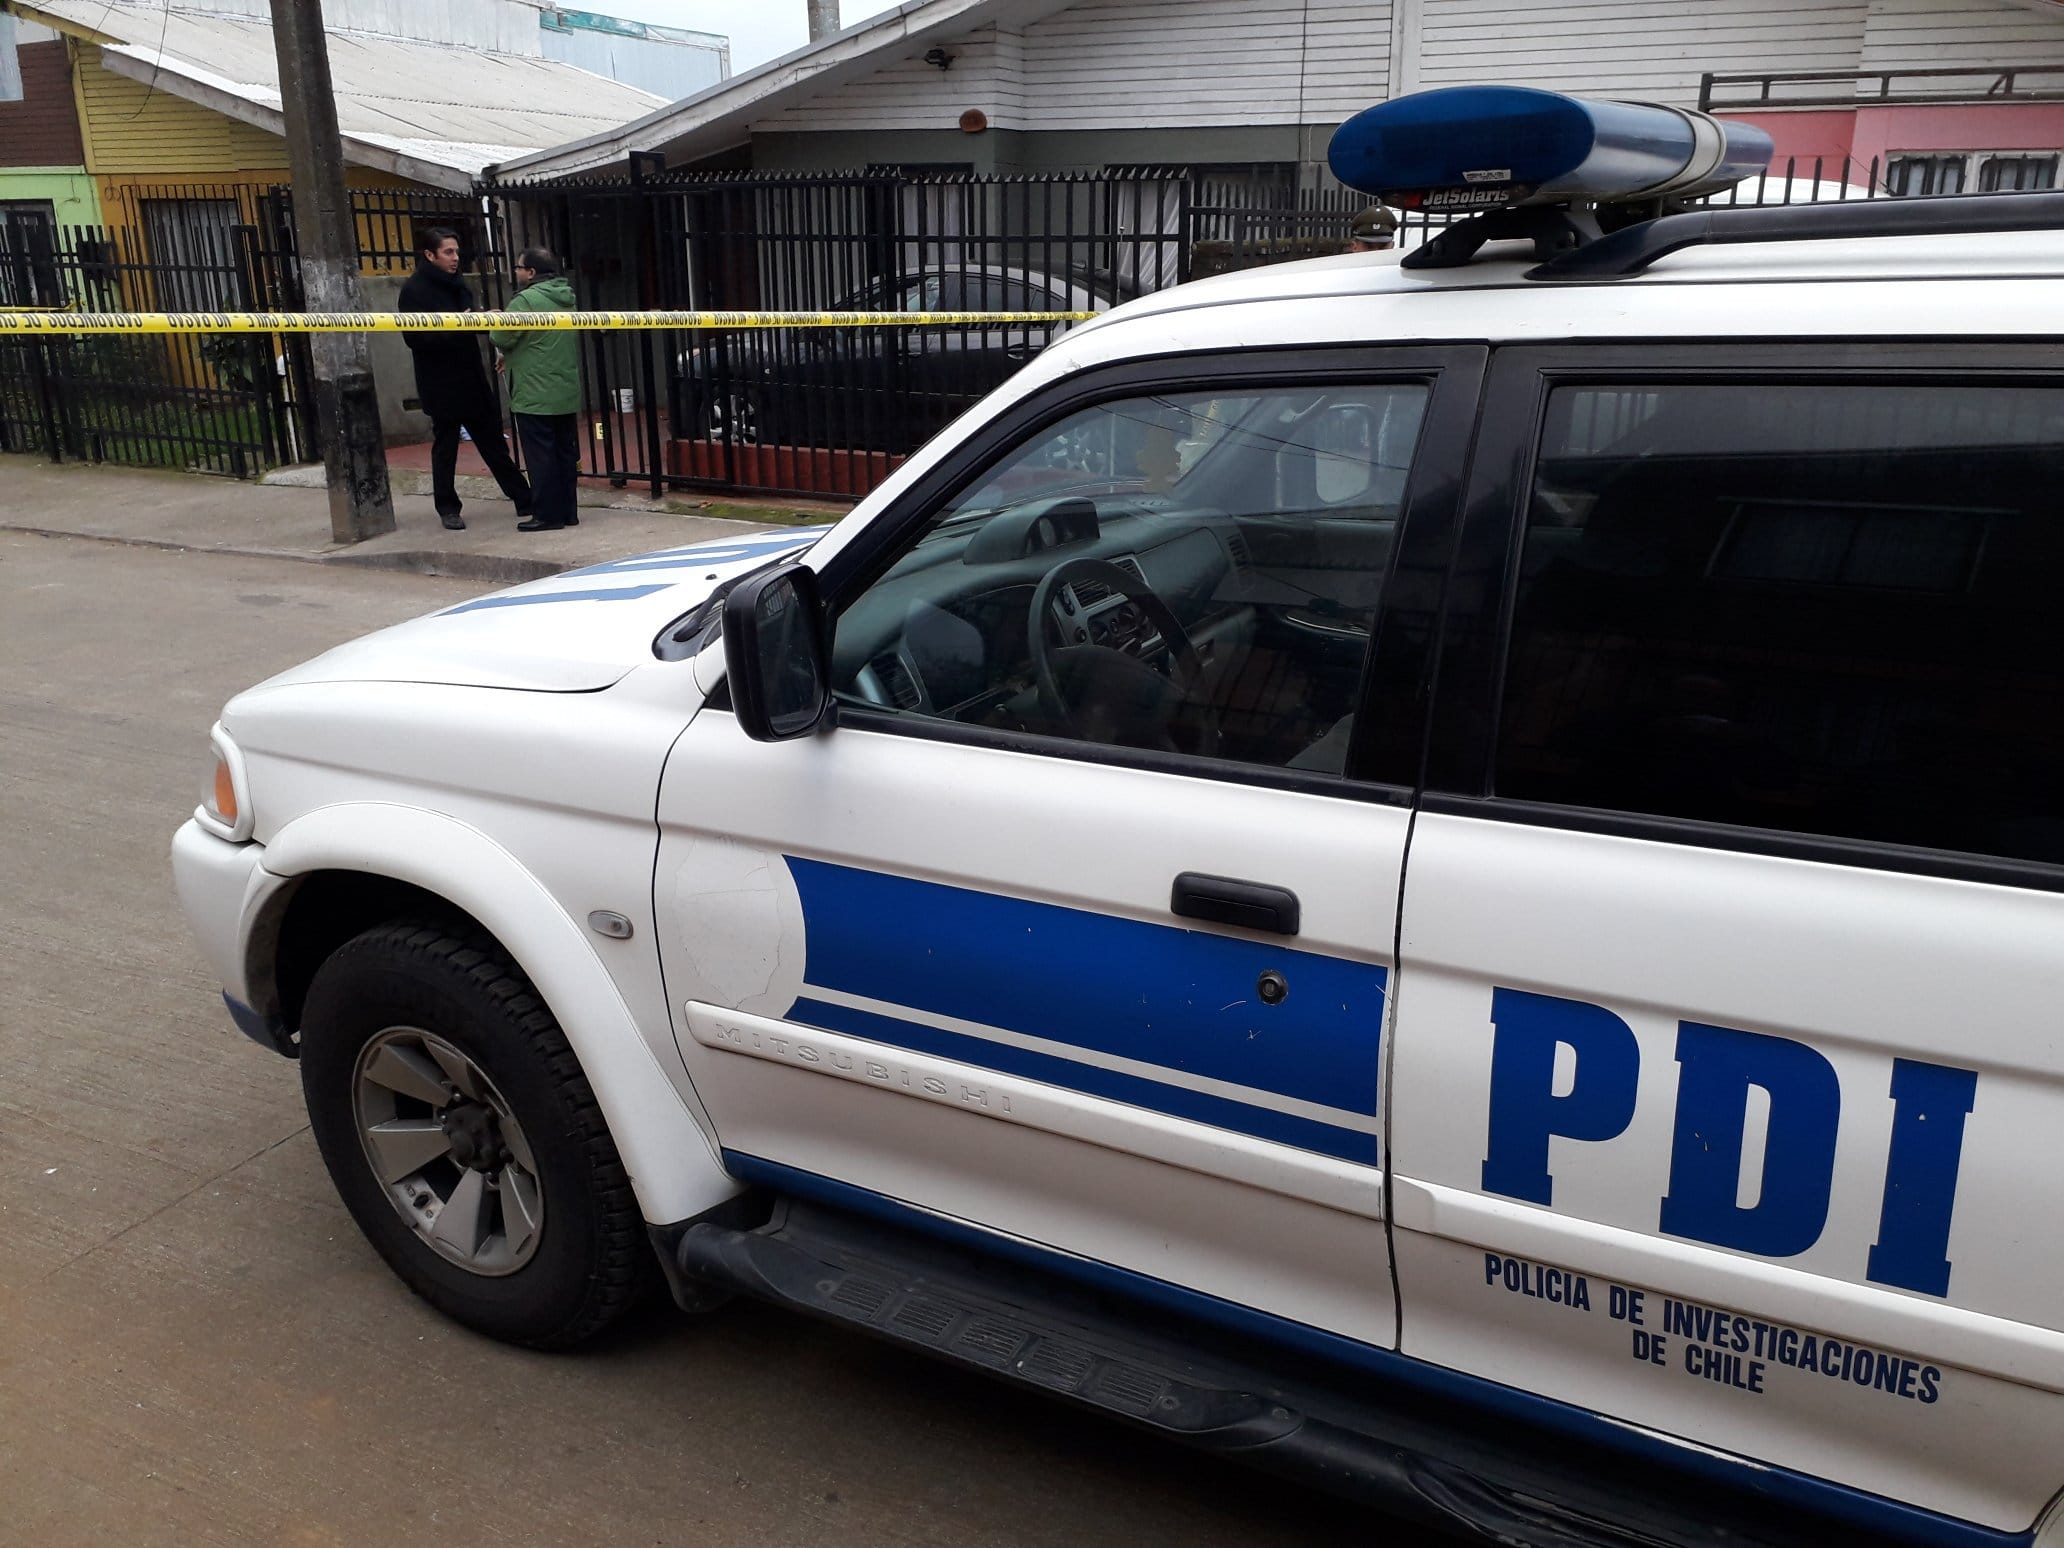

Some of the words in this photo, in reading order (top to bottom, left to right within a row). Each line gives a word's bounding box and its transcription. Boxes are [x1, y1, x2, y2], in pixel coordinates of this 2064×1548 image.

[22, 313, 42, 329] DE
[47, 313, 143, 329] CARABINEROS
[167, 313, 211, 329] PASAR
[213, 313, 232, 328] NO
[247, 313, 280, 328] CHILE
[283, 313, 298, 328] DE
[302, 313, 375, 328] CARABINEROS
[715, 1023, 1014, 1114] MITSUBISHI
[1481, 985, 1979, 1299] PDI
[1484, 1252, 1592, 1313] POLICIA
[1608, 1284, 1645, 1327] DE
[1662, 1299, 1943, 1405] INVESTIGACIONES
[1631, 1329, 1667, 1368] DE
[1684, 1343, 1766, 1395] CHILE
